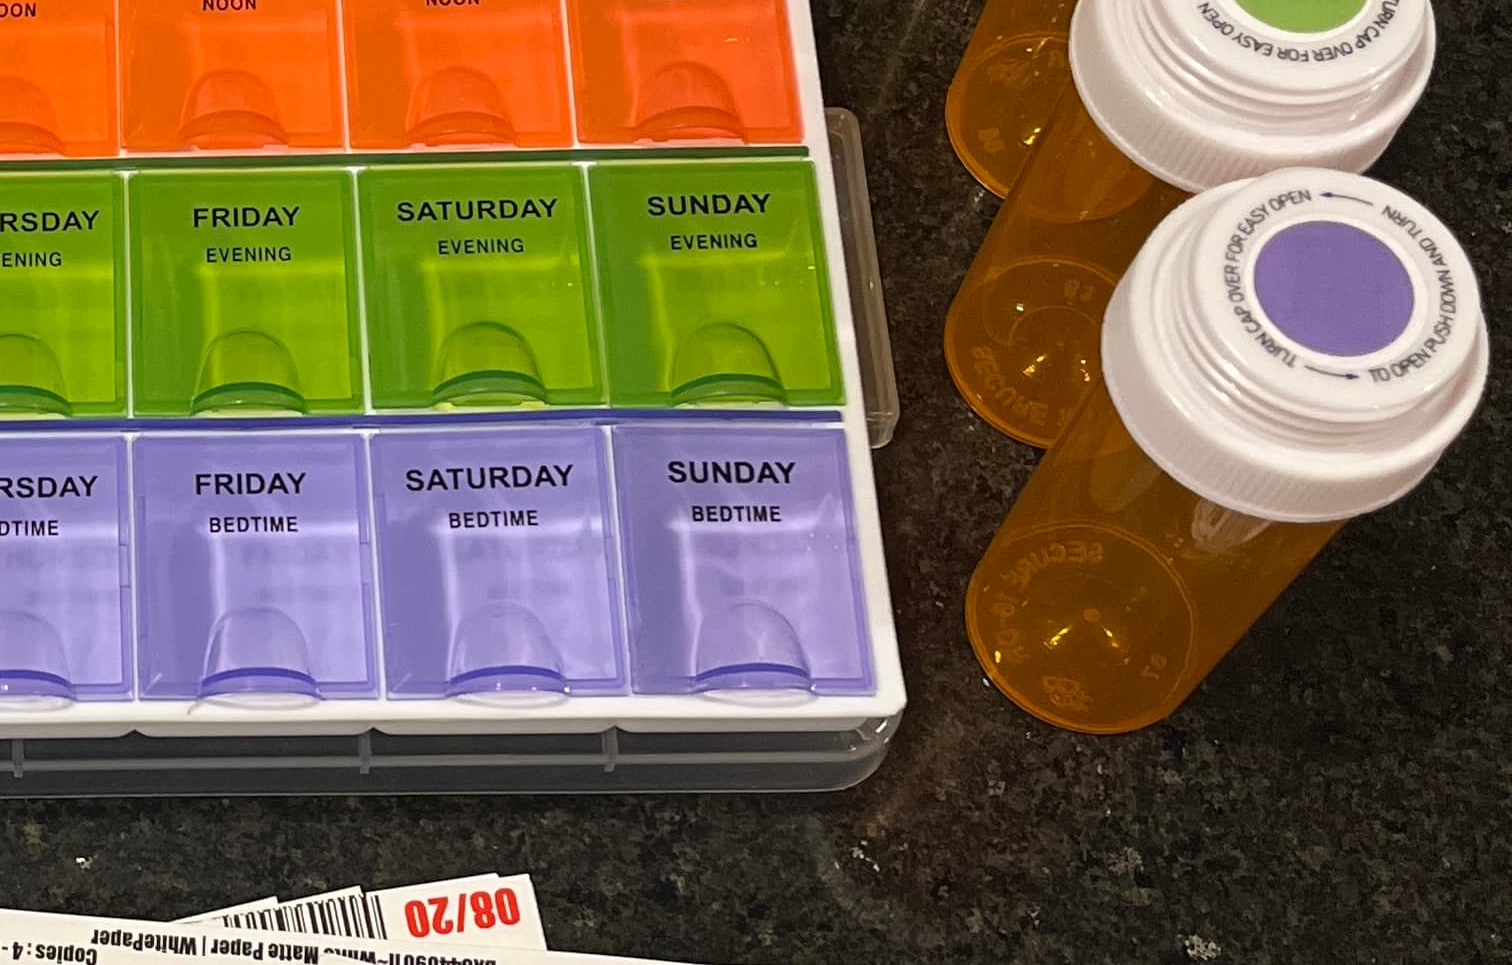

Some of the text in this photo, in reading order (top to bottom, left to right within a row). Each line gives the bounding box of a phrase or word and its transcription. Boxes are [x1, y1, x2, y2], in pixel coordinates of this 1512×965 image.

[1197, 2, 1235, 41] OPEN
[1232, 32, 1274, 57] EASY
[1355, 26, 1381, 50] CAP
[1277, 47, 1310, 63] FOR
[1312, 42, 1354, 63] OVER
[397, 198, 558, 222] SATURDAY
[647, 193, 771, 216] SUNDAY
[193, 206, 300, 228] FRIDAY
[437, 238, 524, 255] EVENING
[670, 233, 758, 251] EVENING
[206, 246, 292, 263] EVENING
[1224, 190, 1312, 368] TURN CAP OVER FOR EASY OPEN
[1368, 205, 1454, 382] TO PUSH AND TURN
[406, 464, 573, 492] SATURDAY
[668, 460, 796, 484] SUNDAY
[195, 472, 306, 496] FRIDAY
[209, 516, 298, 533] BEDTIME
[448, 509, 539, 529] BEDTIME
[691, 505, 782, 522] BEDTIME
[404, 888, 521, 938] 08/20
[12, 941, 24, 960] 4
[90, 929, 197, 956] WhitePaper
[210, 938, 264, 960] Paper
[268, 942, 319, 964] Matte
